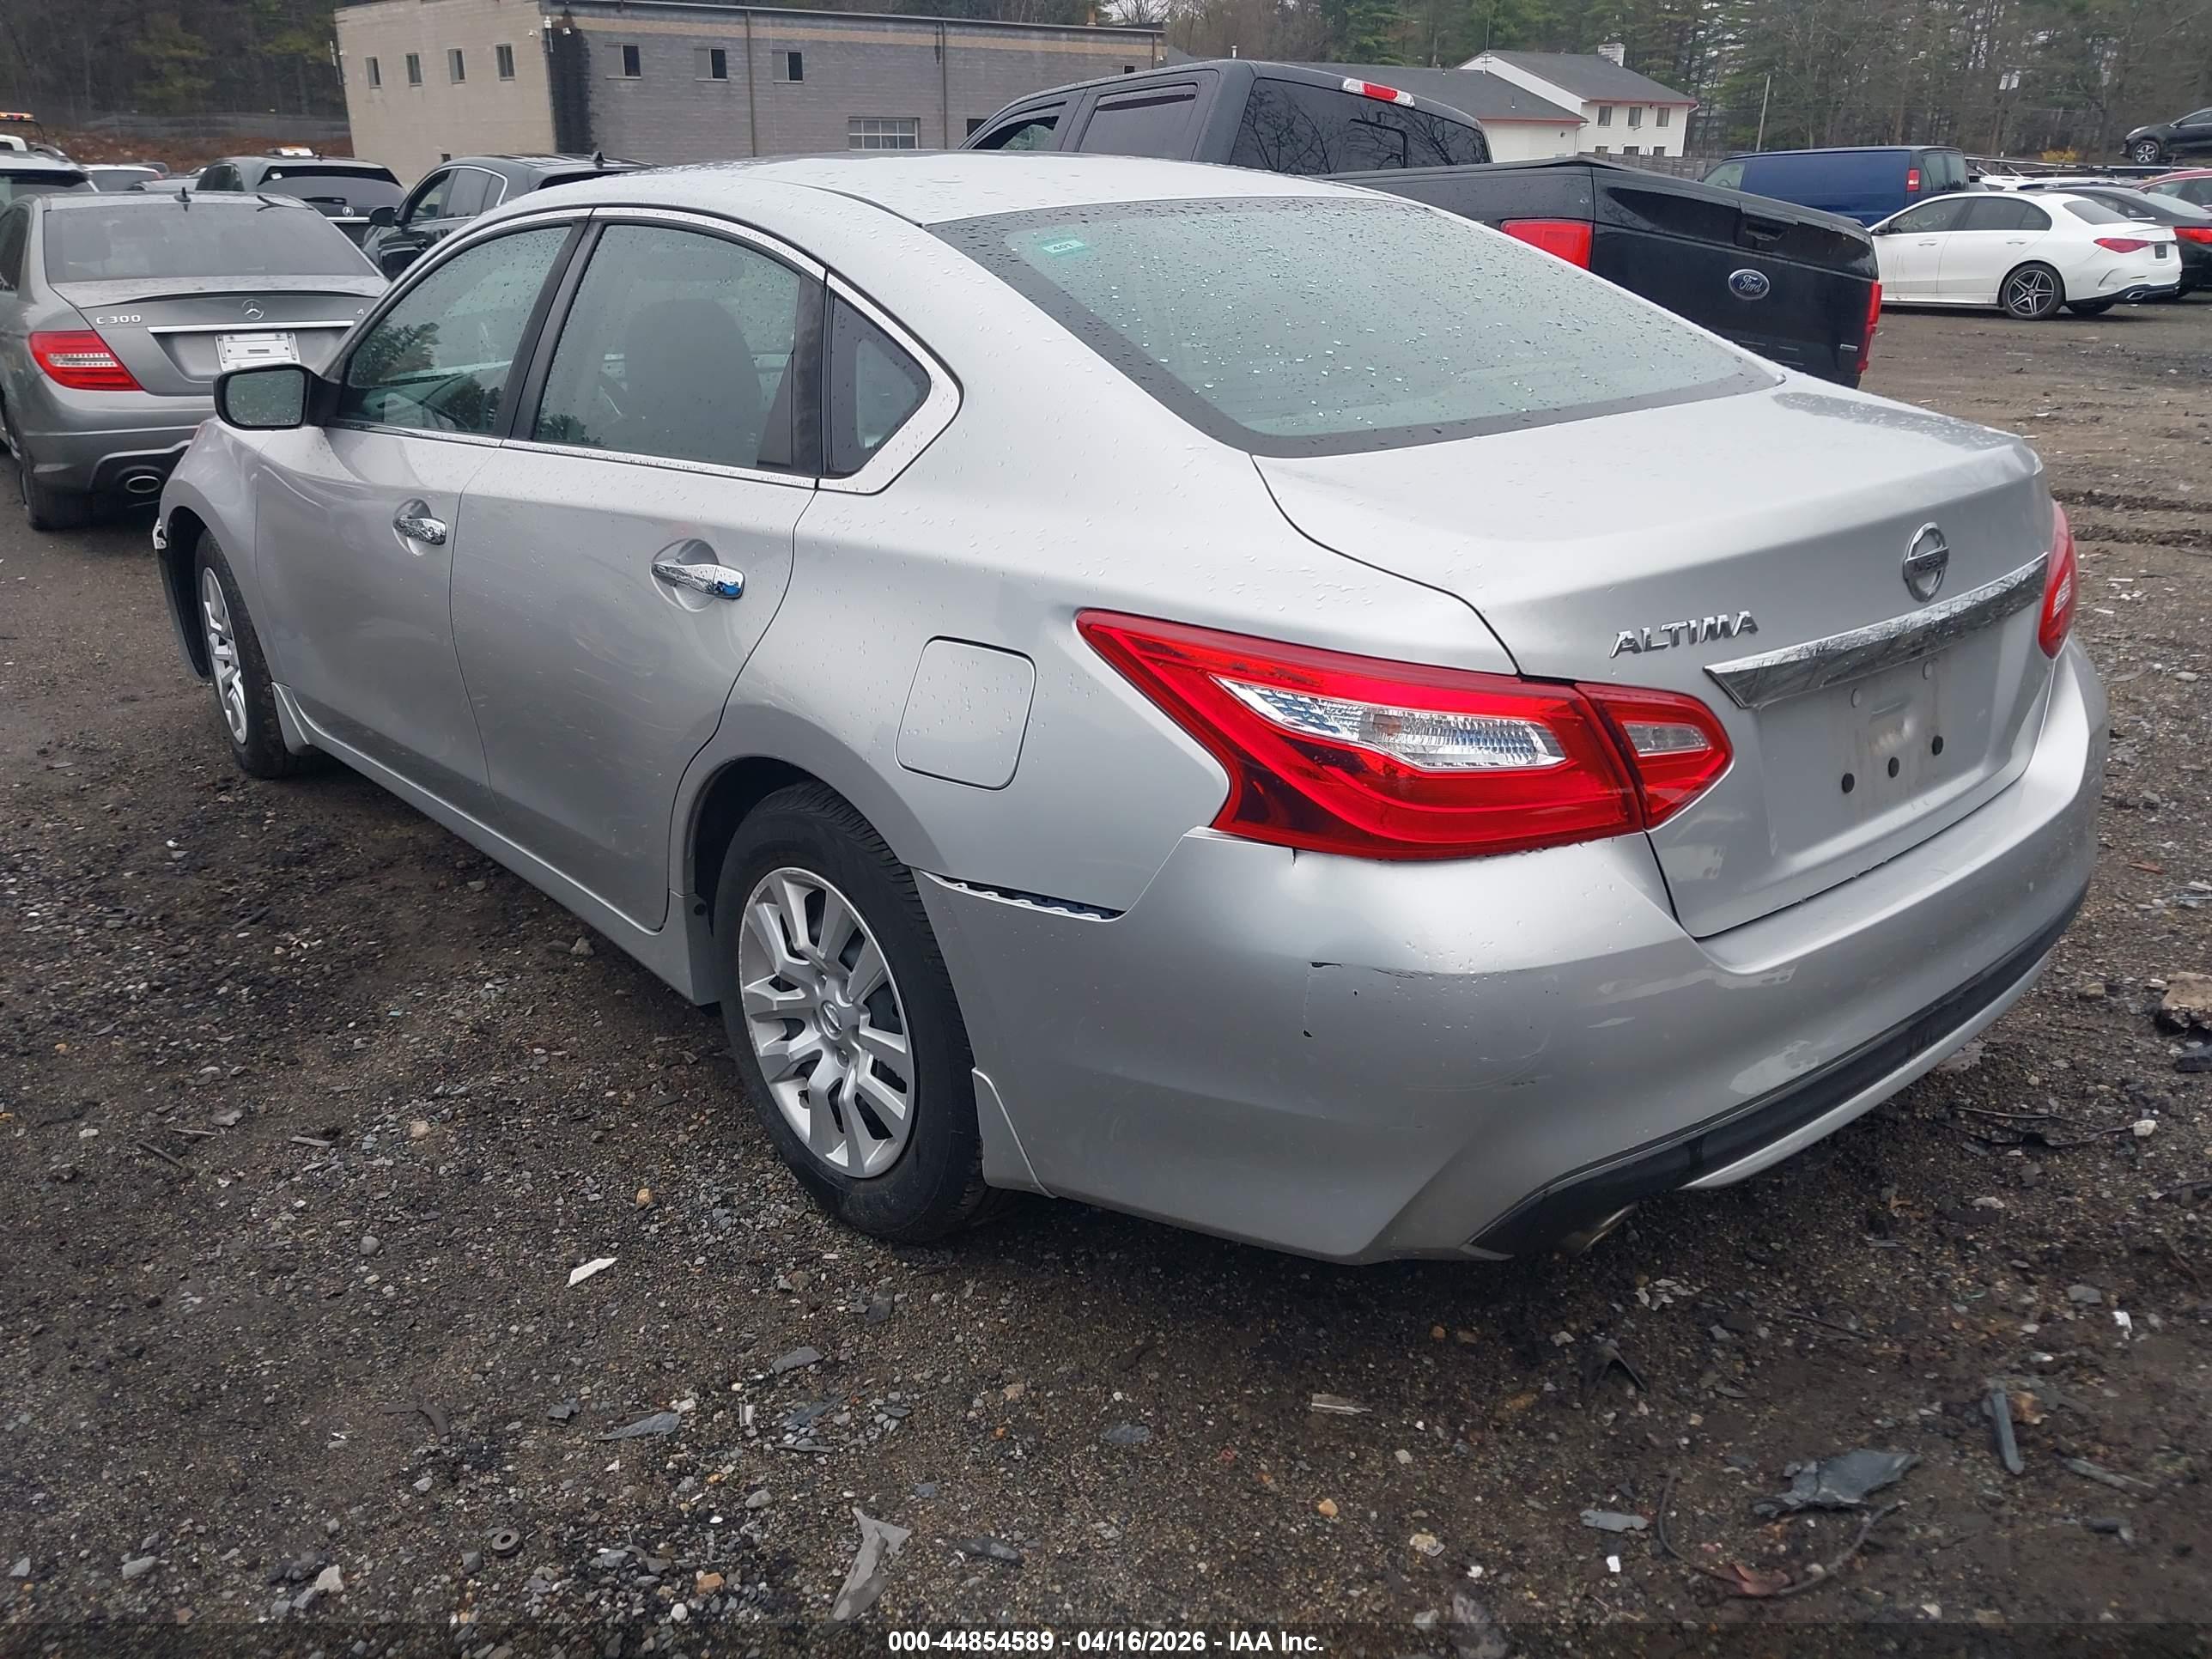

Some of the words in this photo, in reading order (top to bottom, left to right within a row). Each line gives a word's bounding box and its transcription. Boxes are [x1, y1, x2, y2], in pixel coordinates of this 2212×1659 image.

[1739, 274, 1764, 294] Ford
[96, 316, 106, 325] C
[109, 314, 141, 324] 300
[1609, 611, 1759, 658] ALTIMA
